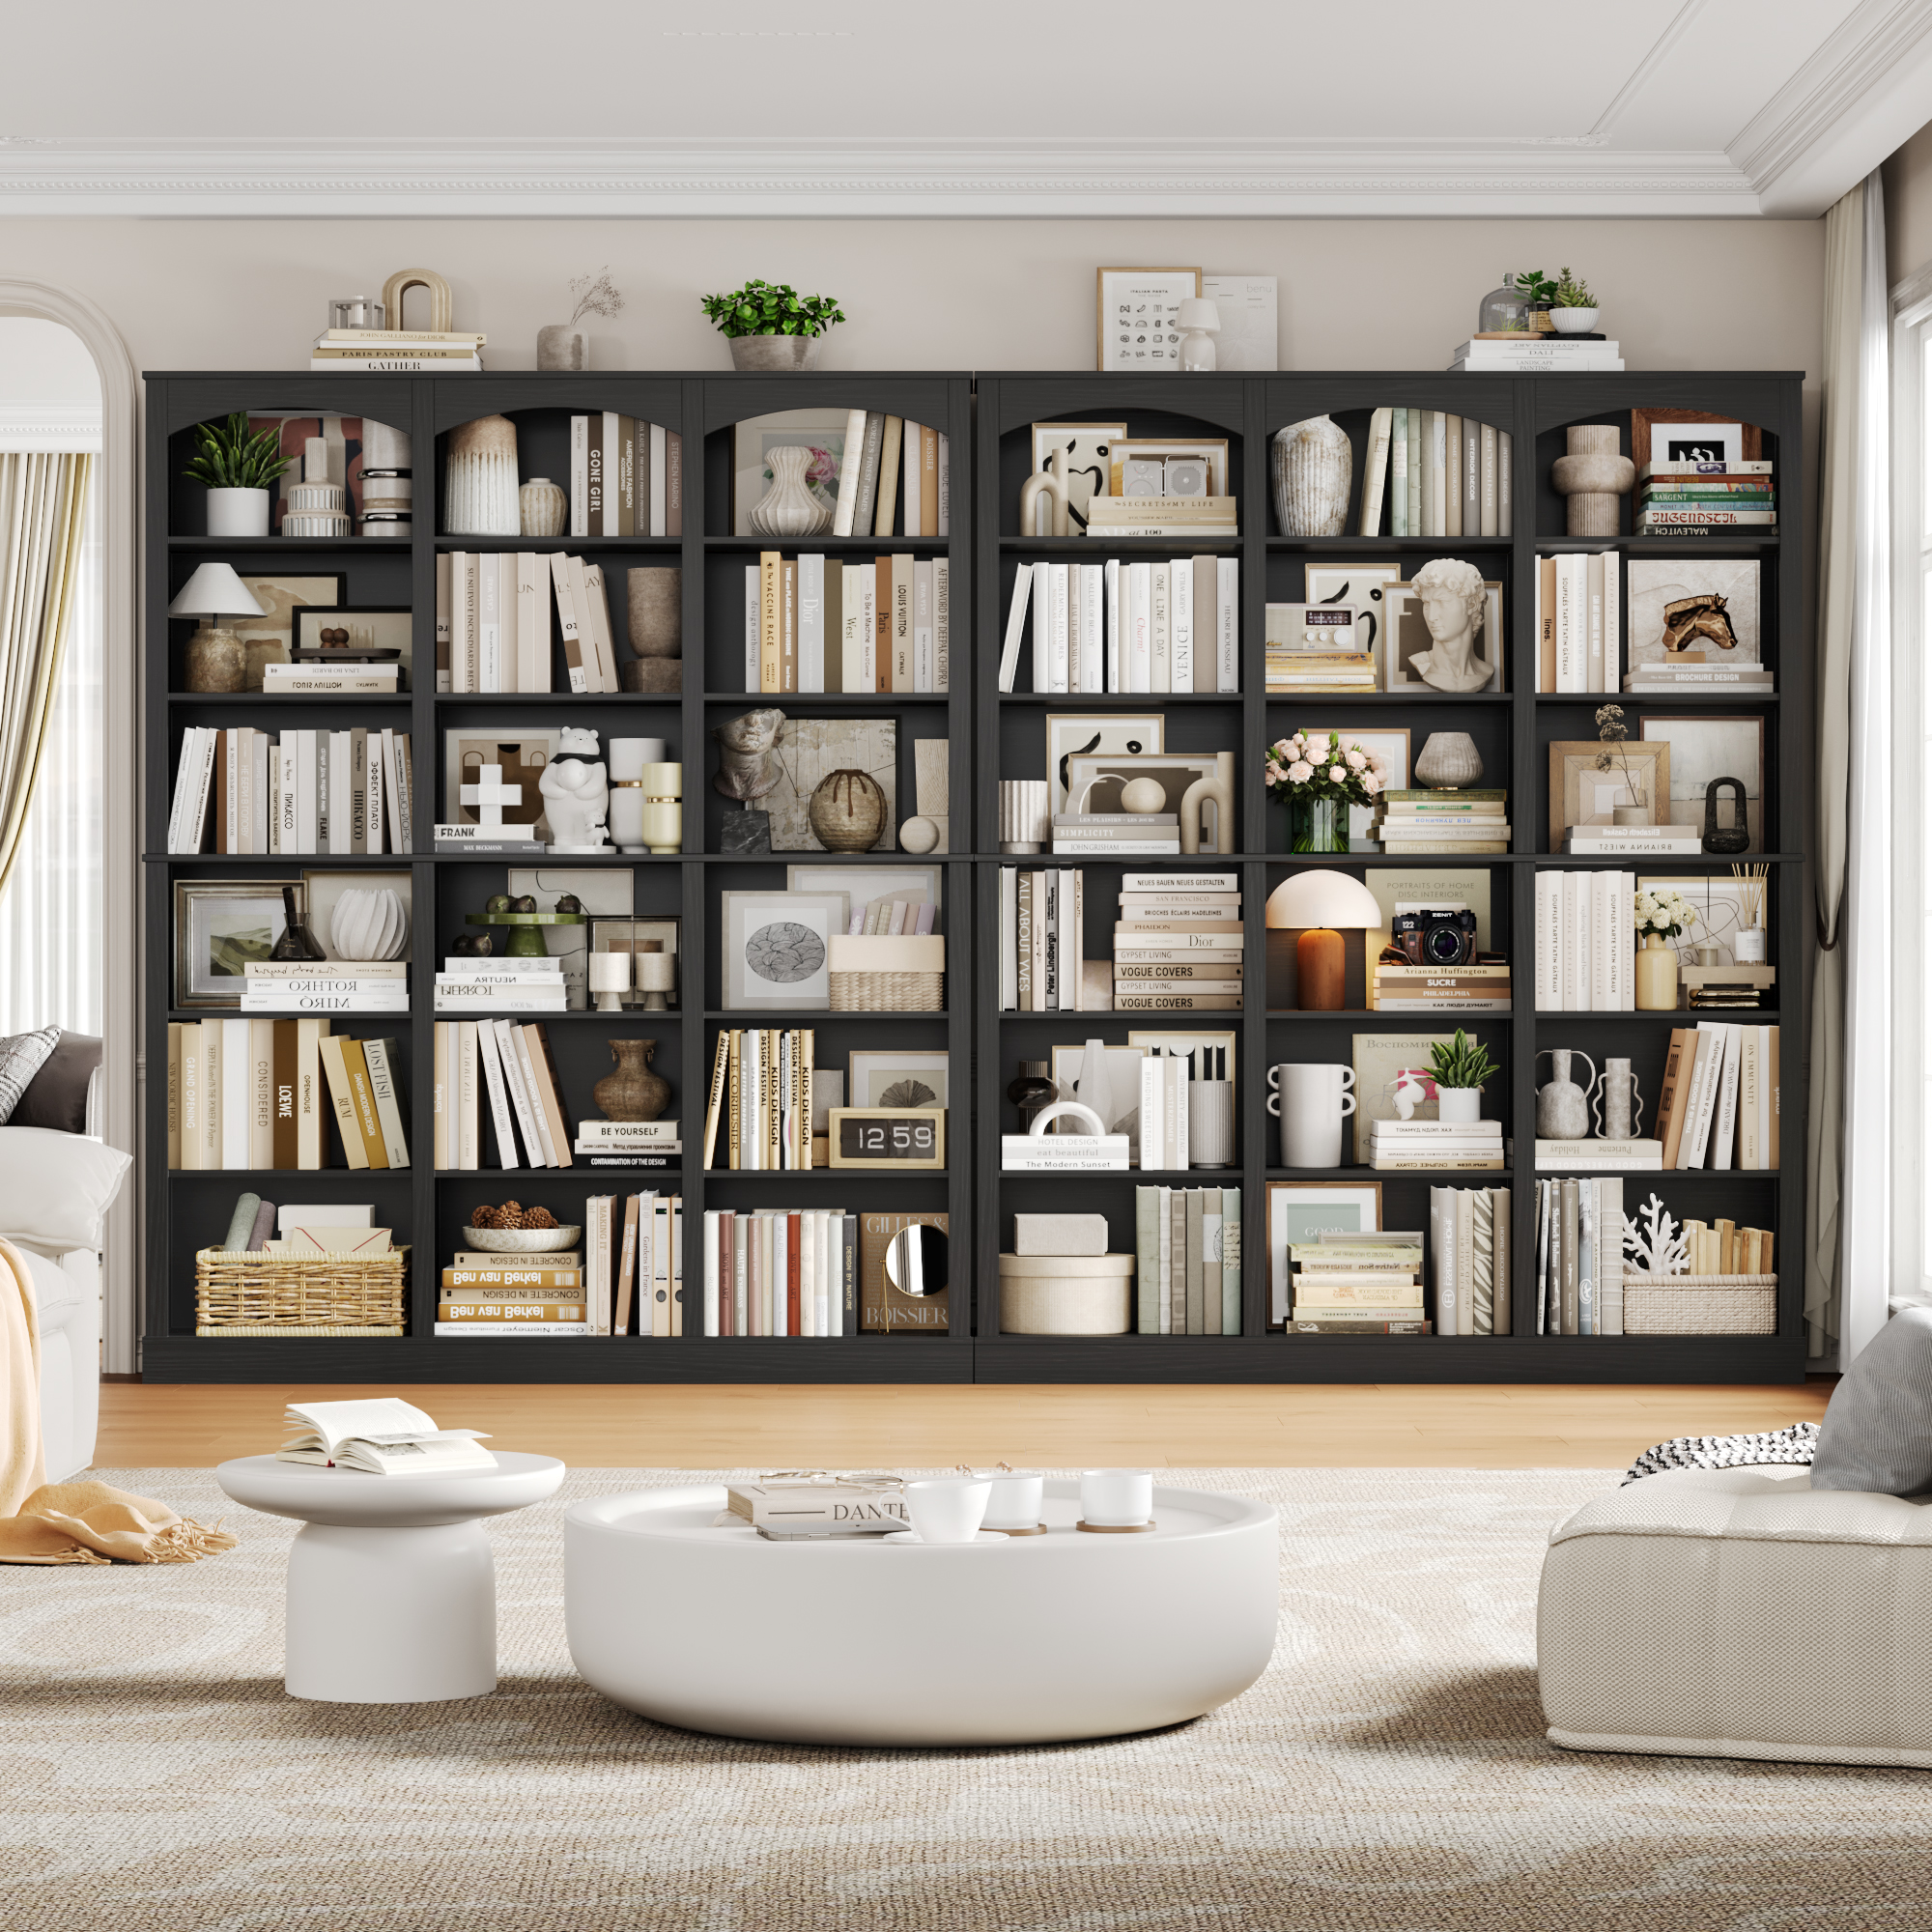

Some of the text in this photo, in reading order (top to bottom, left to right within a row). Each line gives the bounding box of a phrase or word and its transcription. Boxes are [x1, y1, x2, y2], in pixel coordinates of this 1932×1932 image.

[1246, 283, 1272, 293] benu
[861, 419, 879, 513] WORLD'S FINEST HOMES
[907, 444, 917, 497] CLASSIQUES
[590, 449, 601, 513] GONE GIRL
[1652, 513, 1738, 524] JUGENDSTIL
[468, 567, 474, 578] SU
[1156, 574, 1165, 592] ONE
[803, 598, 819, 625] Dior
[1156, 598, 1165, 622] LINE
[846, 617, 856, 639] West
[878, 612, 890, 635] Paris
[938, 567, 948, 686] AFTERWORD BY DEEPAK CHOPRA
[1136, 617, 1146, 653] Charm!
[1156, 639, 1165, 659] DAY
[1178, 625, 1187, 680] VENICE
[284, 793, 293, 830] ПИКАССО
[354, 790, 363, 840] ПИКАССО
[399, 786, 411, 842] НЬЮ-ЙОРК
[440, 828, 475, 837] FRANK
[1019, 878, 1031, 992] ALL ABOUT YVES
[1189, 935, 1215, 947] Dior
[1046, 932, 1057, 973] Lindbergh
[1121, 967, 1194, 977] VOGUE COVERS
[1046, 974, 1057, 995] Peter
[1121, 999, 1194, 1008] VOGUE COVERS
[1747, 1044, 1754, 1056] ON
[368, 1043, 392, 1100] LOST FISH
[186, 1057, 195, 1129] GRAND OPENING
[258, 1061, 269, 1127] CONSIDERED
[279, 1085, 292, 1119] LOEWE
[337, 1097, 353, 1119] RUM
[614, 1127, 659, 1136] YOURSELF
[859, 1126, 932, 1150] 12 59
[1549, 1145, 1580, 1154] Holiday
[600, 1241, 608, 1251] IT
[845, 1273, 852, 1283] BY
[866, 1307, 949, 1324] BOISSIER
